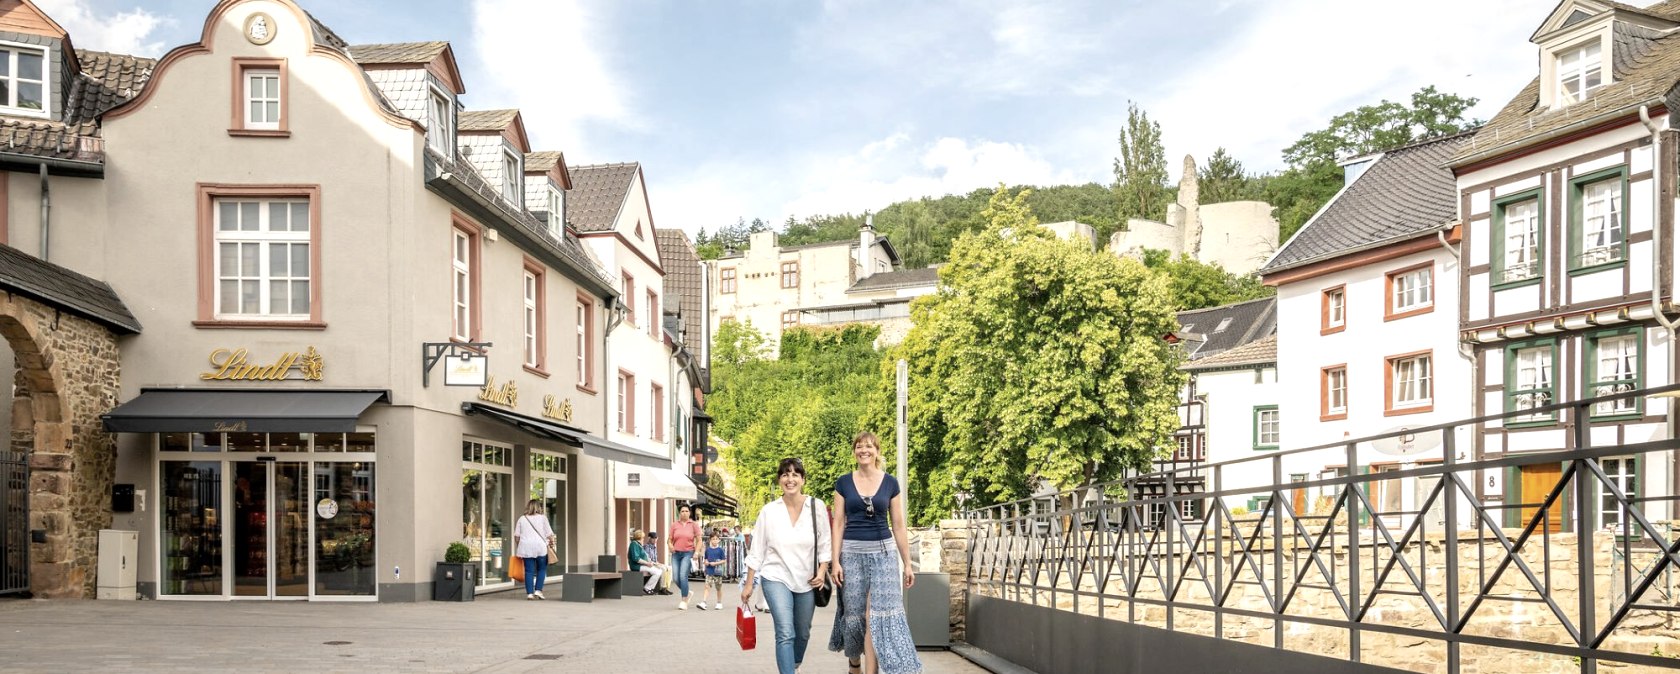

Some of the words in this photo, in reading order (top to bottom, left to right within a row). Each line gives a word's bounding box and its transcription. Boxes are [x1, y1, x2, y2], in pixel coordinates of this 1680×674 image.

[199, 347, 300, 381] Lindt
[478, 374, 509, 405] Lindt
[542, 394, 566, 419] Lindt
[212, 420, 240, 432] Lindt
[1489, 475, 1495, 488] 8
